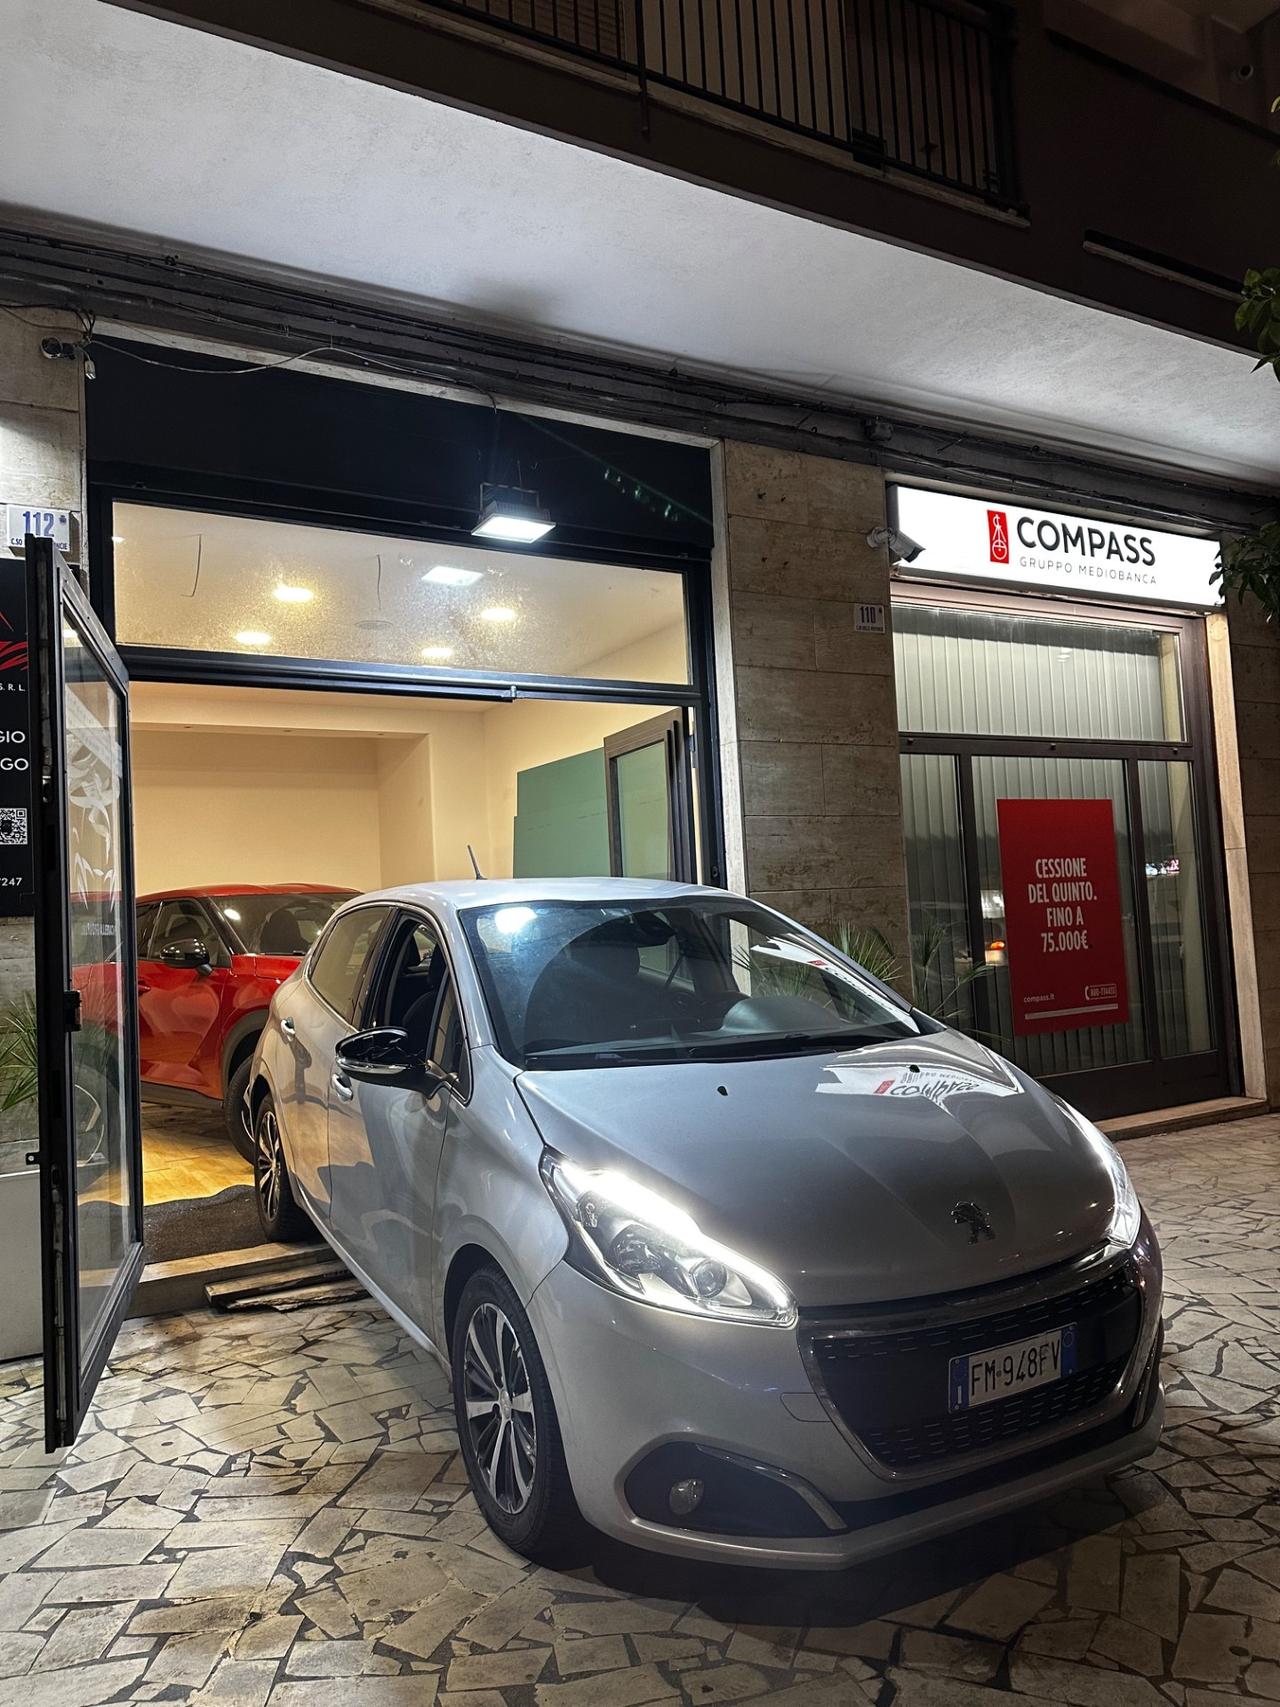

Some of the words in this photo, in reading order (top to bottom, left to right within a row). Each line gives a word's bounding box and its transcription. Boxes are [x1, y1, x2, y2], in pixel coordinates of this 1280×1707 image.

[23, 511, 54, 537] 112
[1017, 516, 1156, 566] COMPASS
[1019, 556, 1073, 573] GRUPPO
[1079, 565, 1157, 584] MEDIOBANCA
[1035, 857, 1087, 878] CESSIONE
[1028, 883, 1049, 904] DEL
[1052, 881, 1097, 902] QUINTO.
[1046, 906, 1073, 927] FINO
[1076, 906, 1084, 925] A
[1041, 930, 1088, 952] 75.000€
